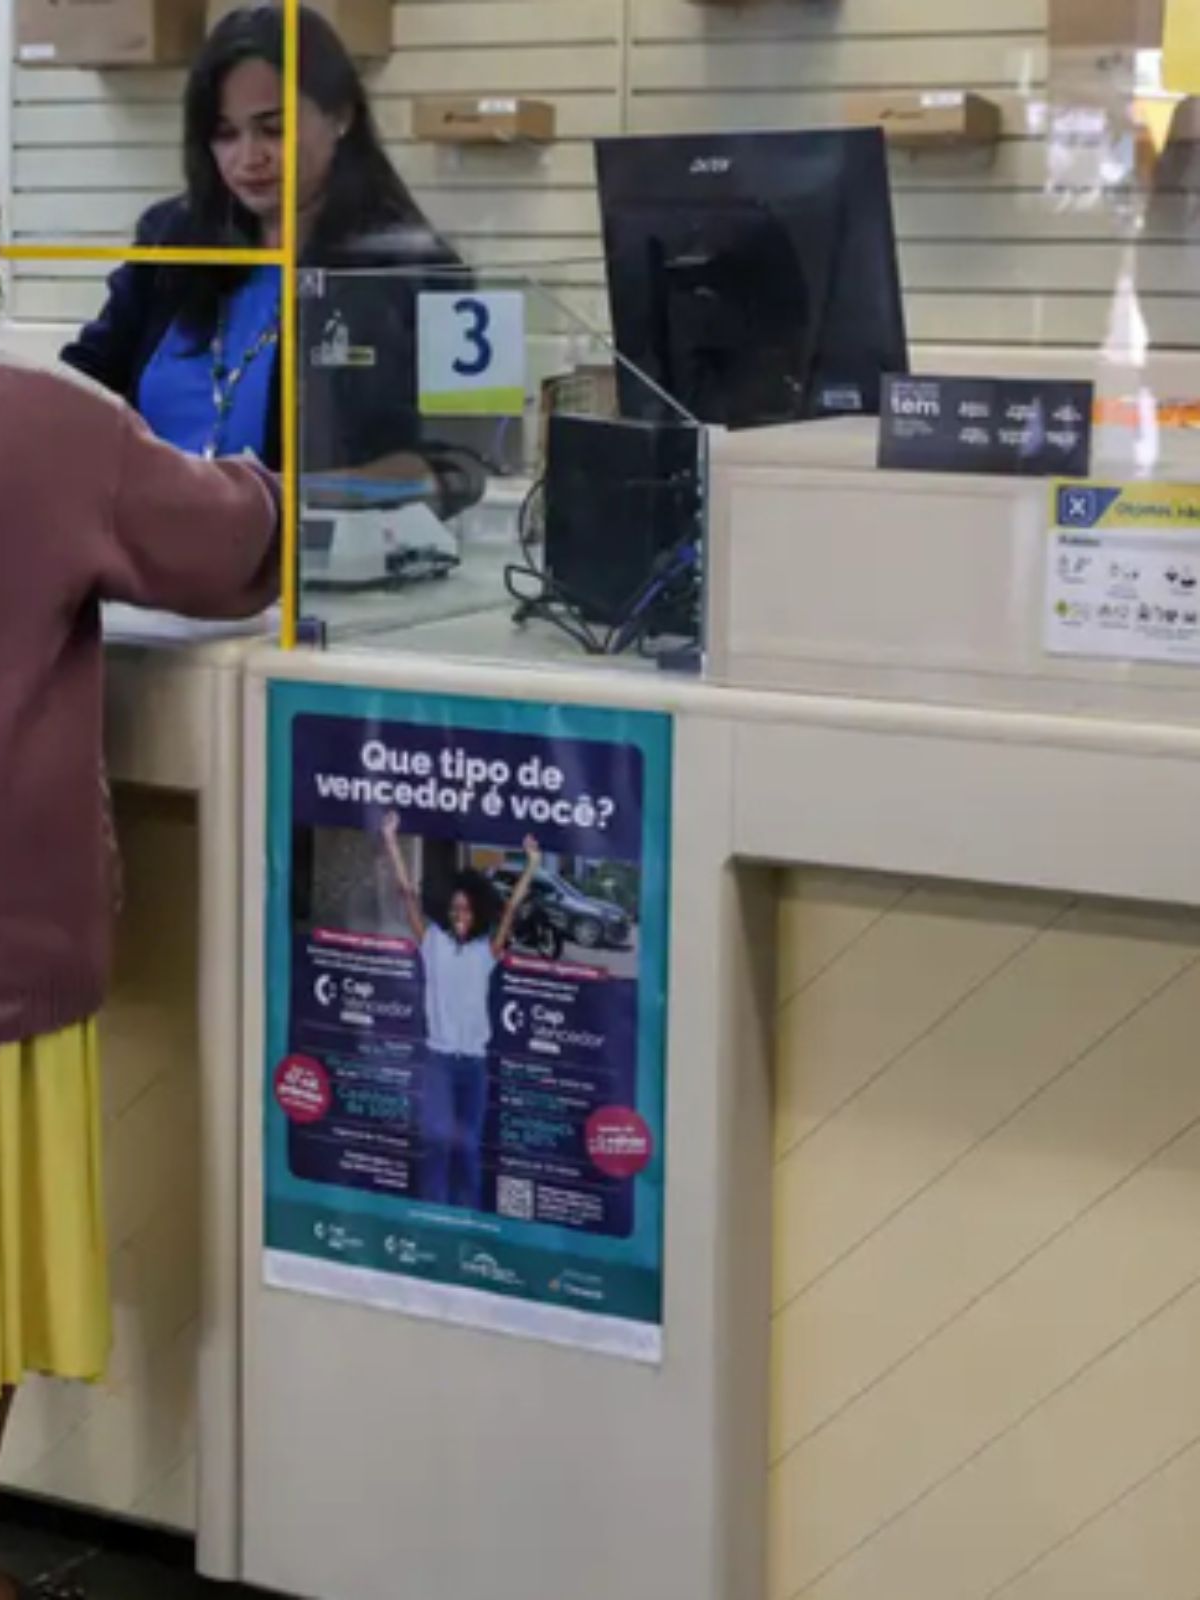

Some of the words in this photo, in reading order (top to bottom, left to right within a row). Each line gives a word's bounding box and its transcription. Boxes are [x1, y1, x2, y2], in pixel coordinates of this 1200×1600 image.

[451, 298, 493, 377] 3
[361, 739, 432, 776] Que
[440, 747, 510, 788] tipo
[517, 755, 564, 790] de
[315, 772, 475, 814] vencedor
[510, 793, 615, 829] você?
